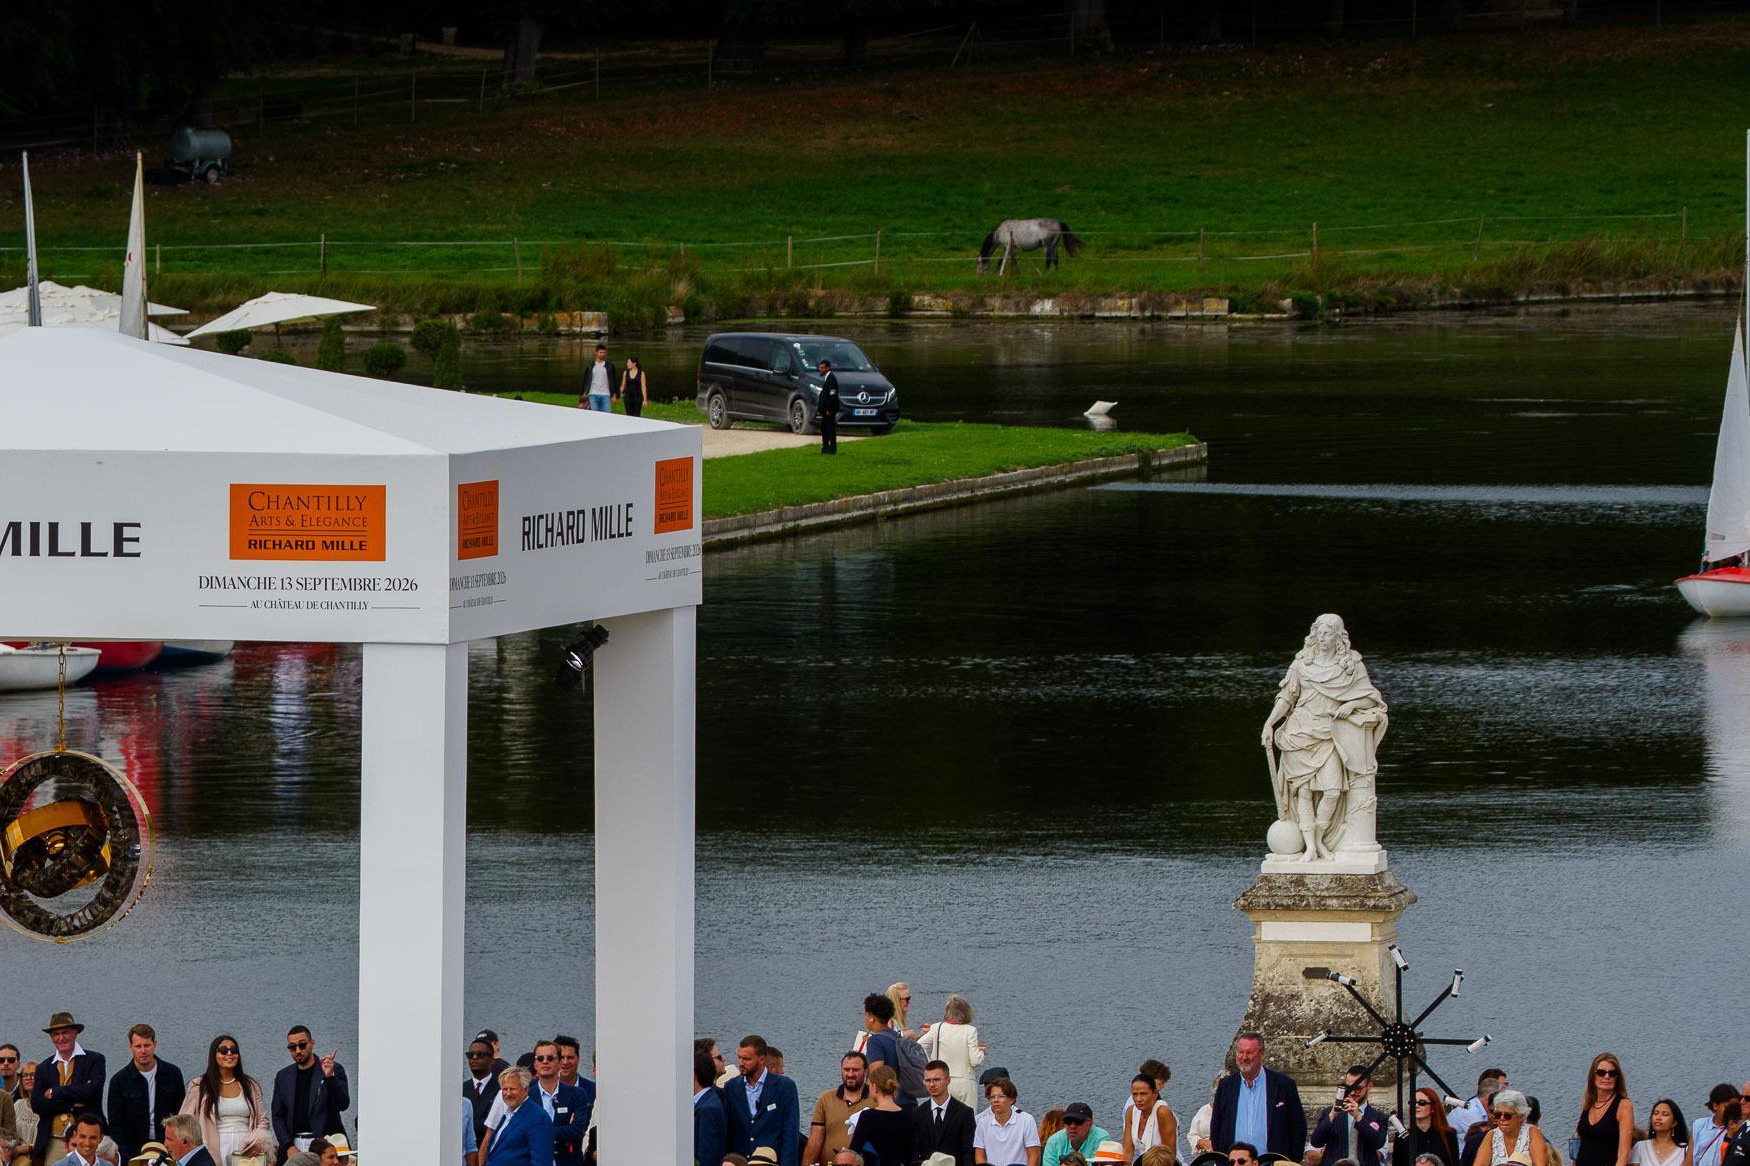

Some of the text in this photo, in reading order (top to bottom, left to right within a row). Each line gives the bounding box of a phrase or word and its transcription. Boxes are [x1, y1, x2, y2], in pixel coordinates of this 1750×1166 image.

[248, 490, 368, 511] CHANTILLY
[249, 514, 368, 528] ARTS & ELEGANCE
[521, 508, 586, 552] RICHARD
[590, 502, 634, 543] MILLE
[248, 539, 368, 551] RICHARD MILLE
[198, 575, 419, 592] DIMANCHE 13 SEPTEMBRE 2026
[249, 598, 369, 611] AU CHÂTEAU DE CHANTILLY
